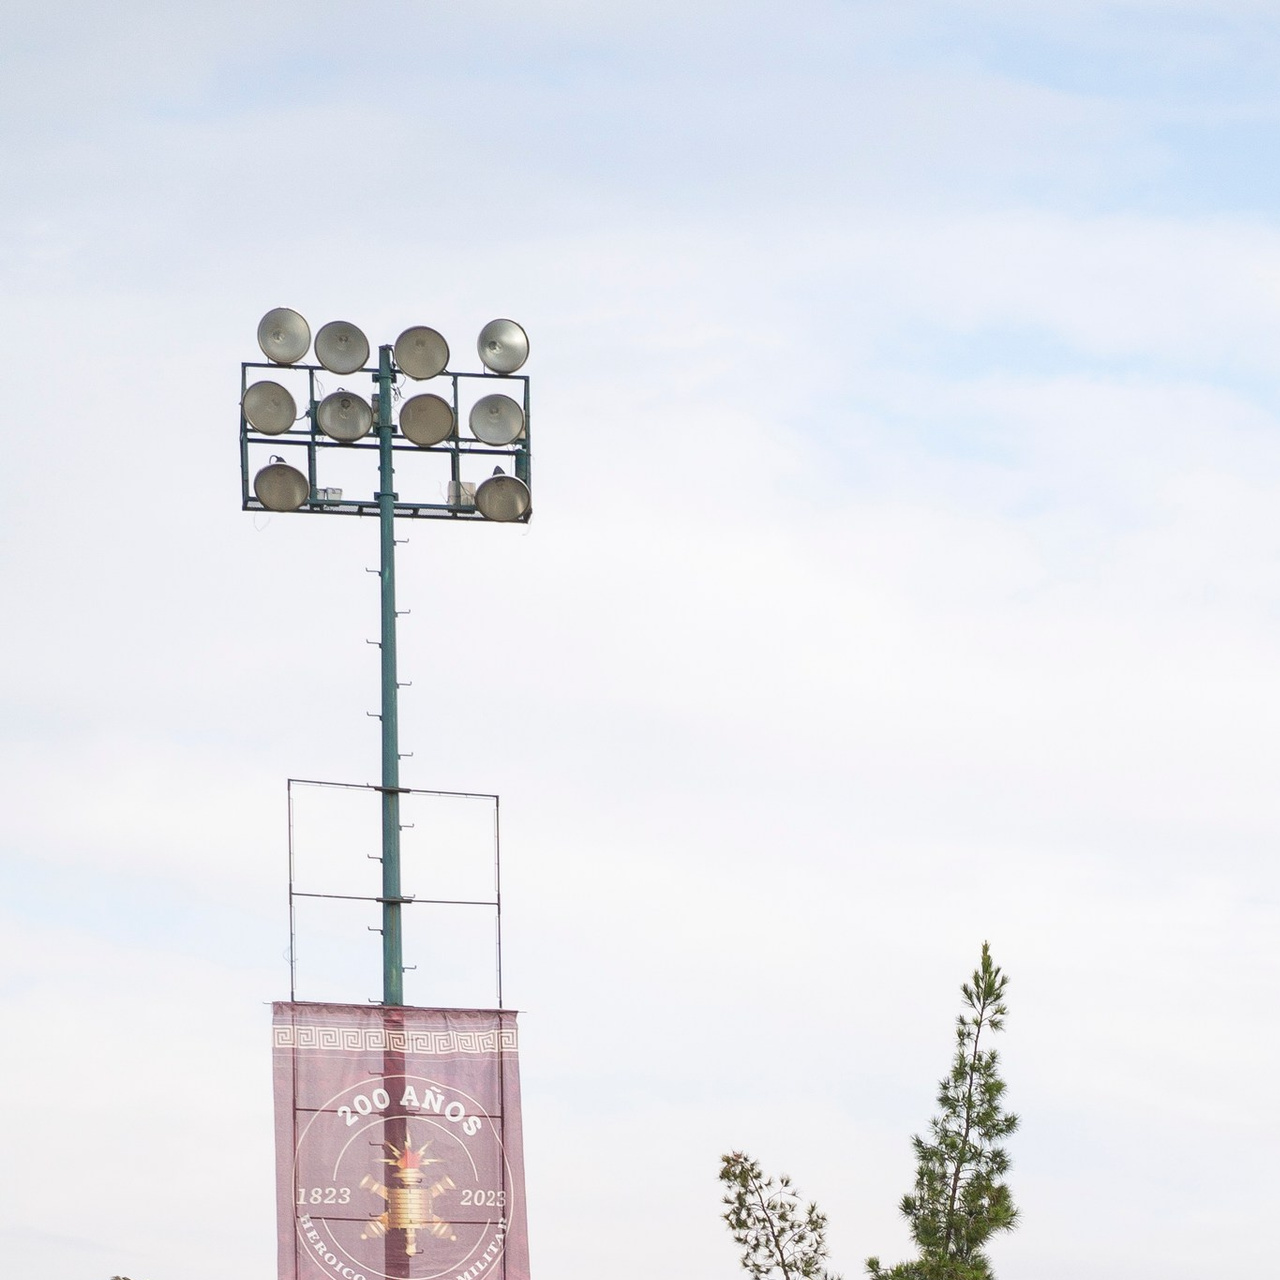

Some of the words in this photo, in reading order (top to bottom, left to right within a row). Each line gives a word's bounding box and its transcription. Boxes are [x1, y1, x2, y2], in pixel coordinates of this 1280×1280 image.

[338, 1088, 390, 1127] 200
[400, 1085, 482, 1136] AÑOS
[296, 1187, 351, 1205] 1823
[460, 1189, 506, 1207] 2023
